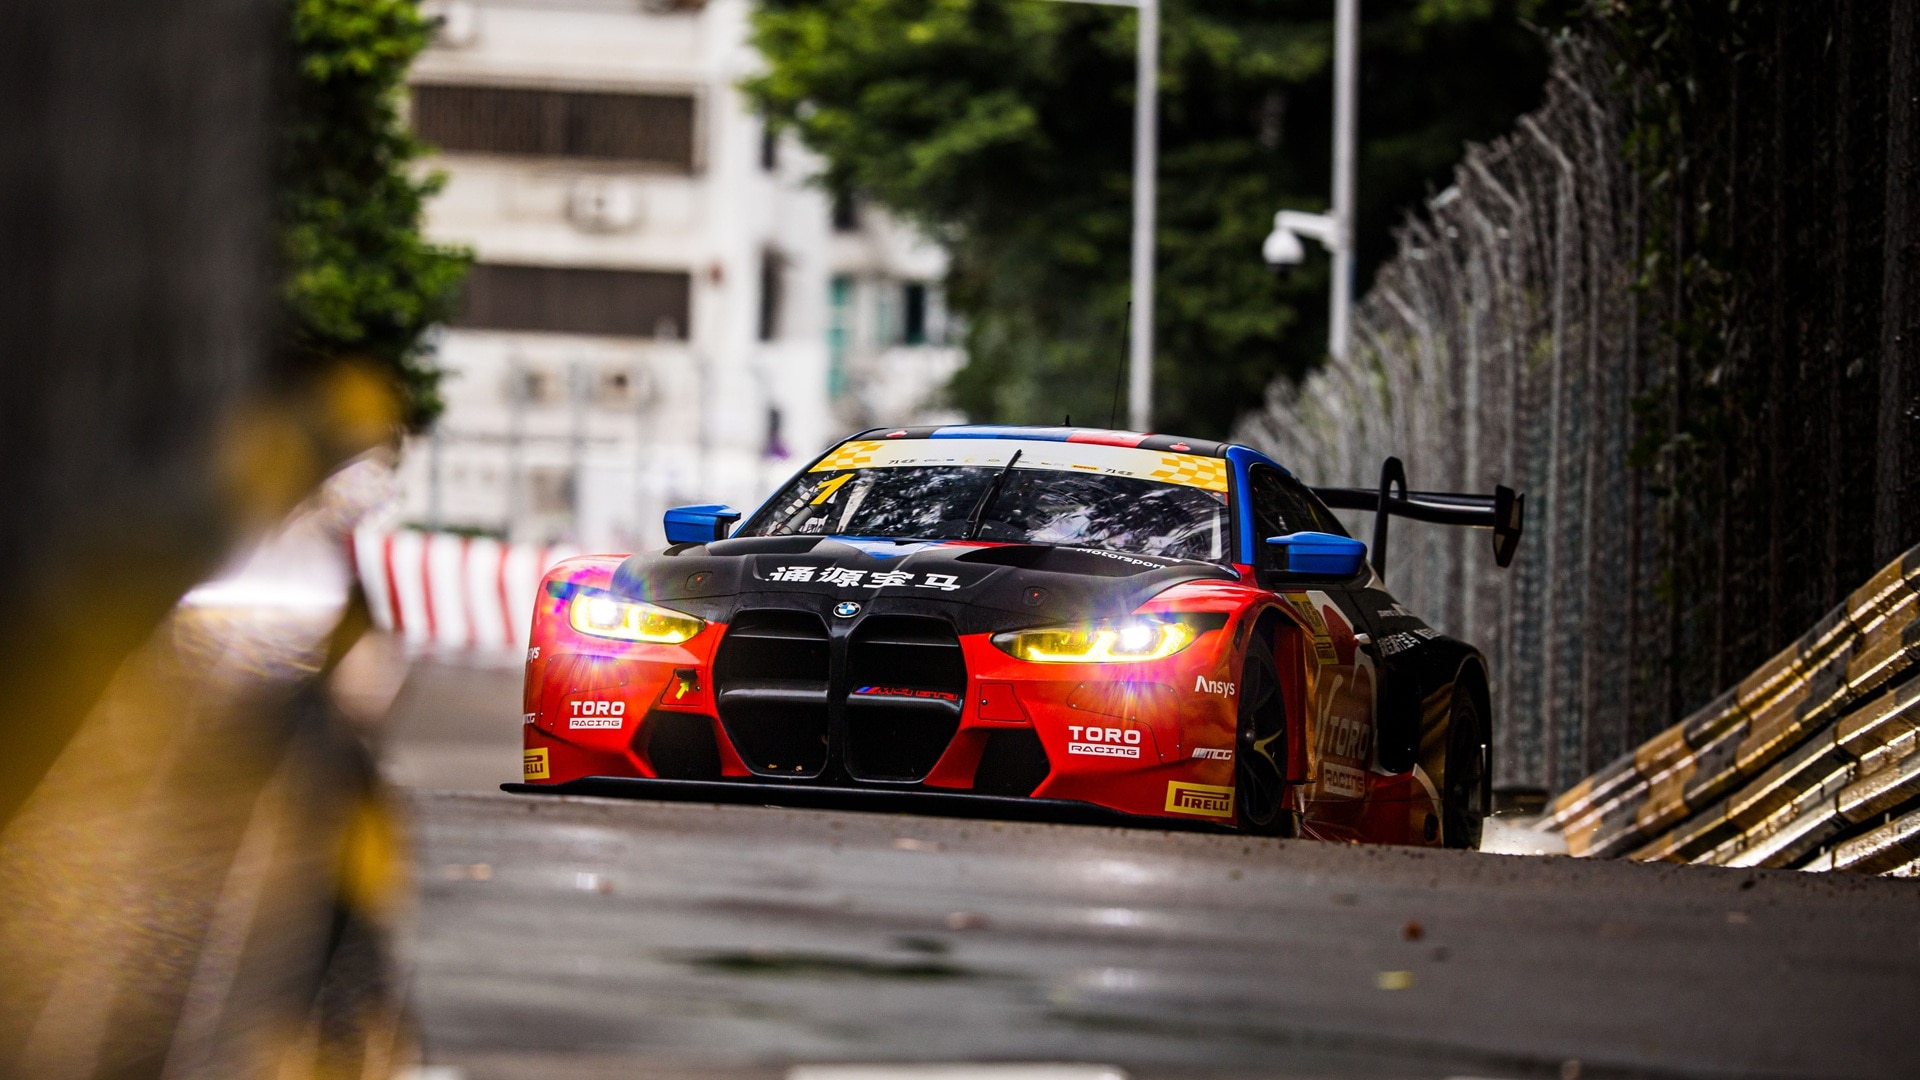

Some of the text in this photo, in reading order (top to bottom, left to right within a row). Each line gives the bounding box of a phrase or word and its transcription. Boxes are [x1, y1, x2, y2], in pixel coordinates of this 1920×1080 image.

[809, 473, 856, 505] 1
[1194, 675, 1236, 698] Ansys
[570, 701, 625, 716] TORO
[1068, 725, 1141, 744] TORO
[1328, 715, 1370, 760] TORO
[1071, 745, 1138, 756] RACING
[1173, 788, 1231, 812] PIRELLI
